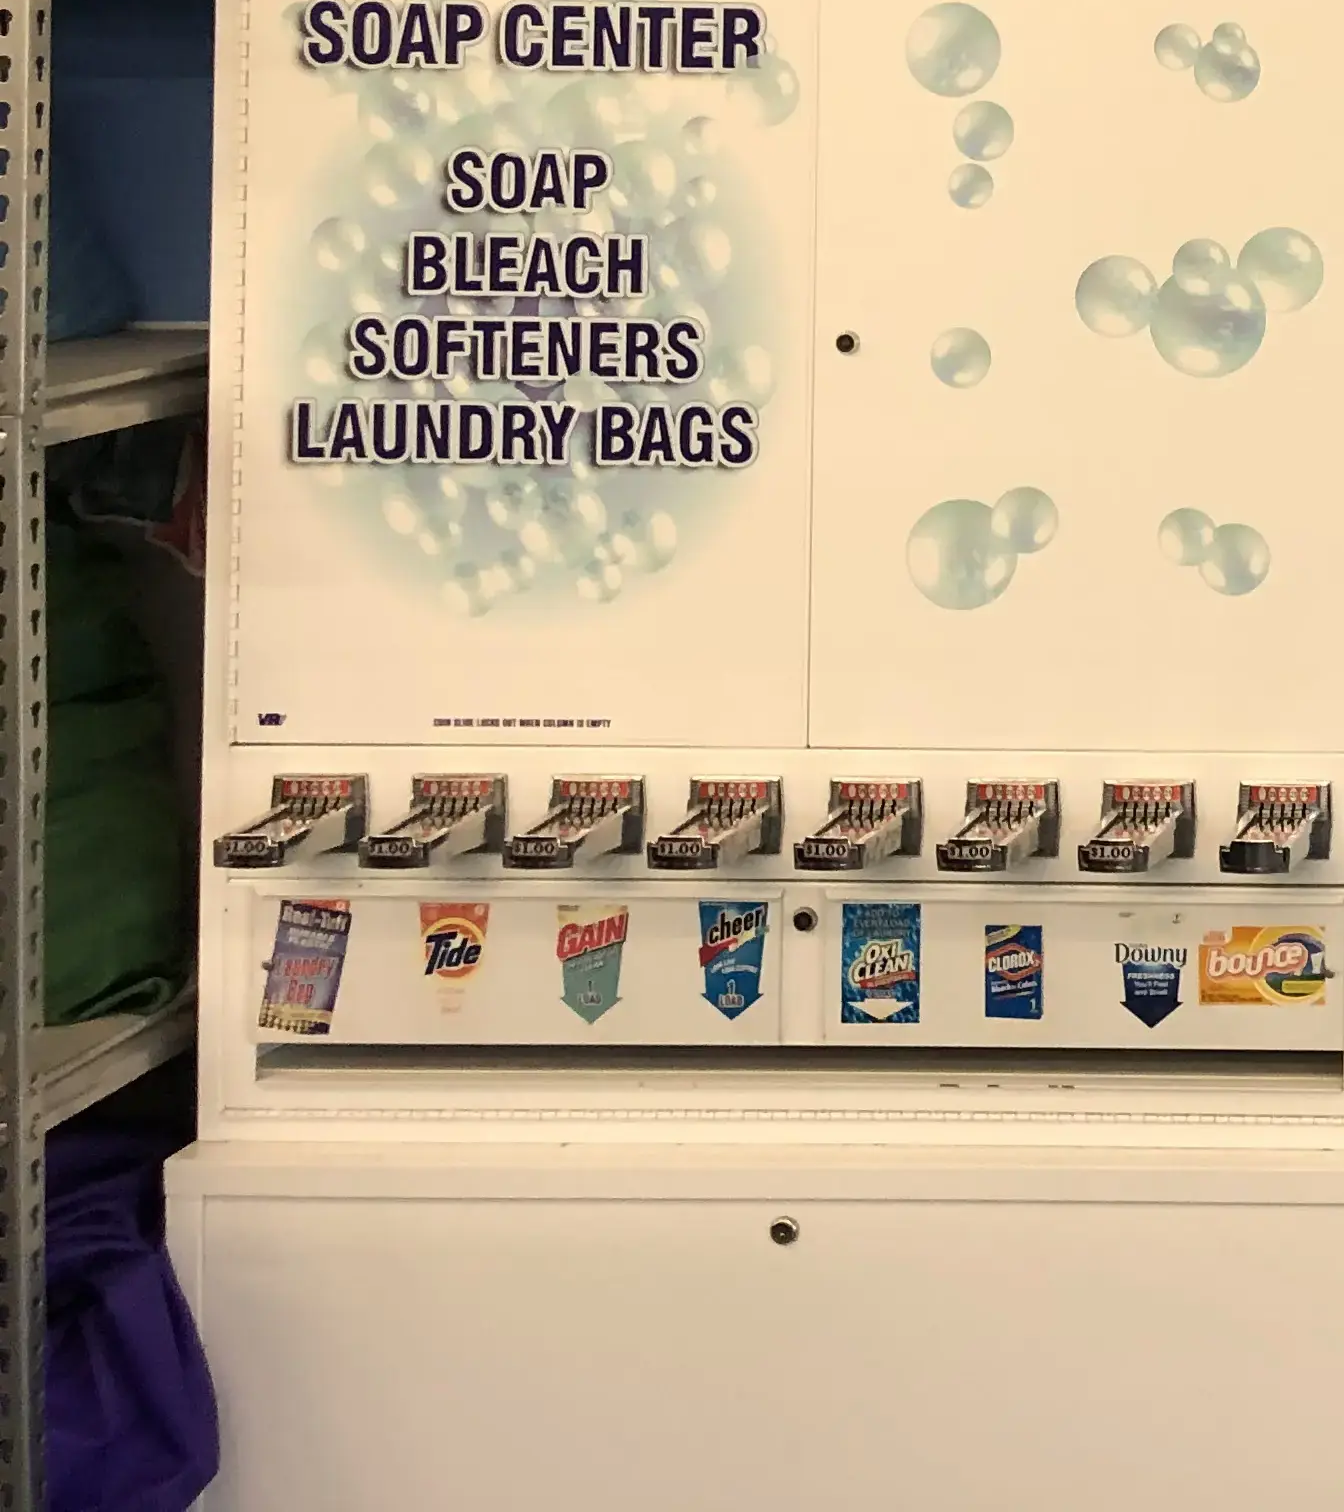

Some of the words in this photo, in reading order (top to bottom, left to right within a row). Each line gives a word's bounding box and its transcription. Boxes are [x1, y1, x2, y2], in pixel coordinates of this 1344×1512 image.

[306, 0, 484, 68] SOAP
[502, 2, 764, 70] CENTER
[451, 151, 611, 210] SOAP
[411, 235, 647, 294] BLEACH
[352, 318, 703, 380] SOFTENERS
[294, 402, 577, 461] LAUNDRY
[598, 405, 758, 465] BAGS
[659, 842, 700, 855] $1.00
[805, 843, 846, 857] $1.00
[949, 844, 990, 858] $1.00
[1091, 847, 1131, 858] $1.00
[557, 912, 628, 962] GAIN
[708, 906, 766, 945] cheer
[425, 931, 482, 975] Tide
[852, 952, 911, 982] CLEAN
[865, 942, 898, 965] OXI
[988, 951, 1035, 973] CLOROX
[1114, 942, 1187, 968] Downy
[1207, 947, 1303, 978] bounce
